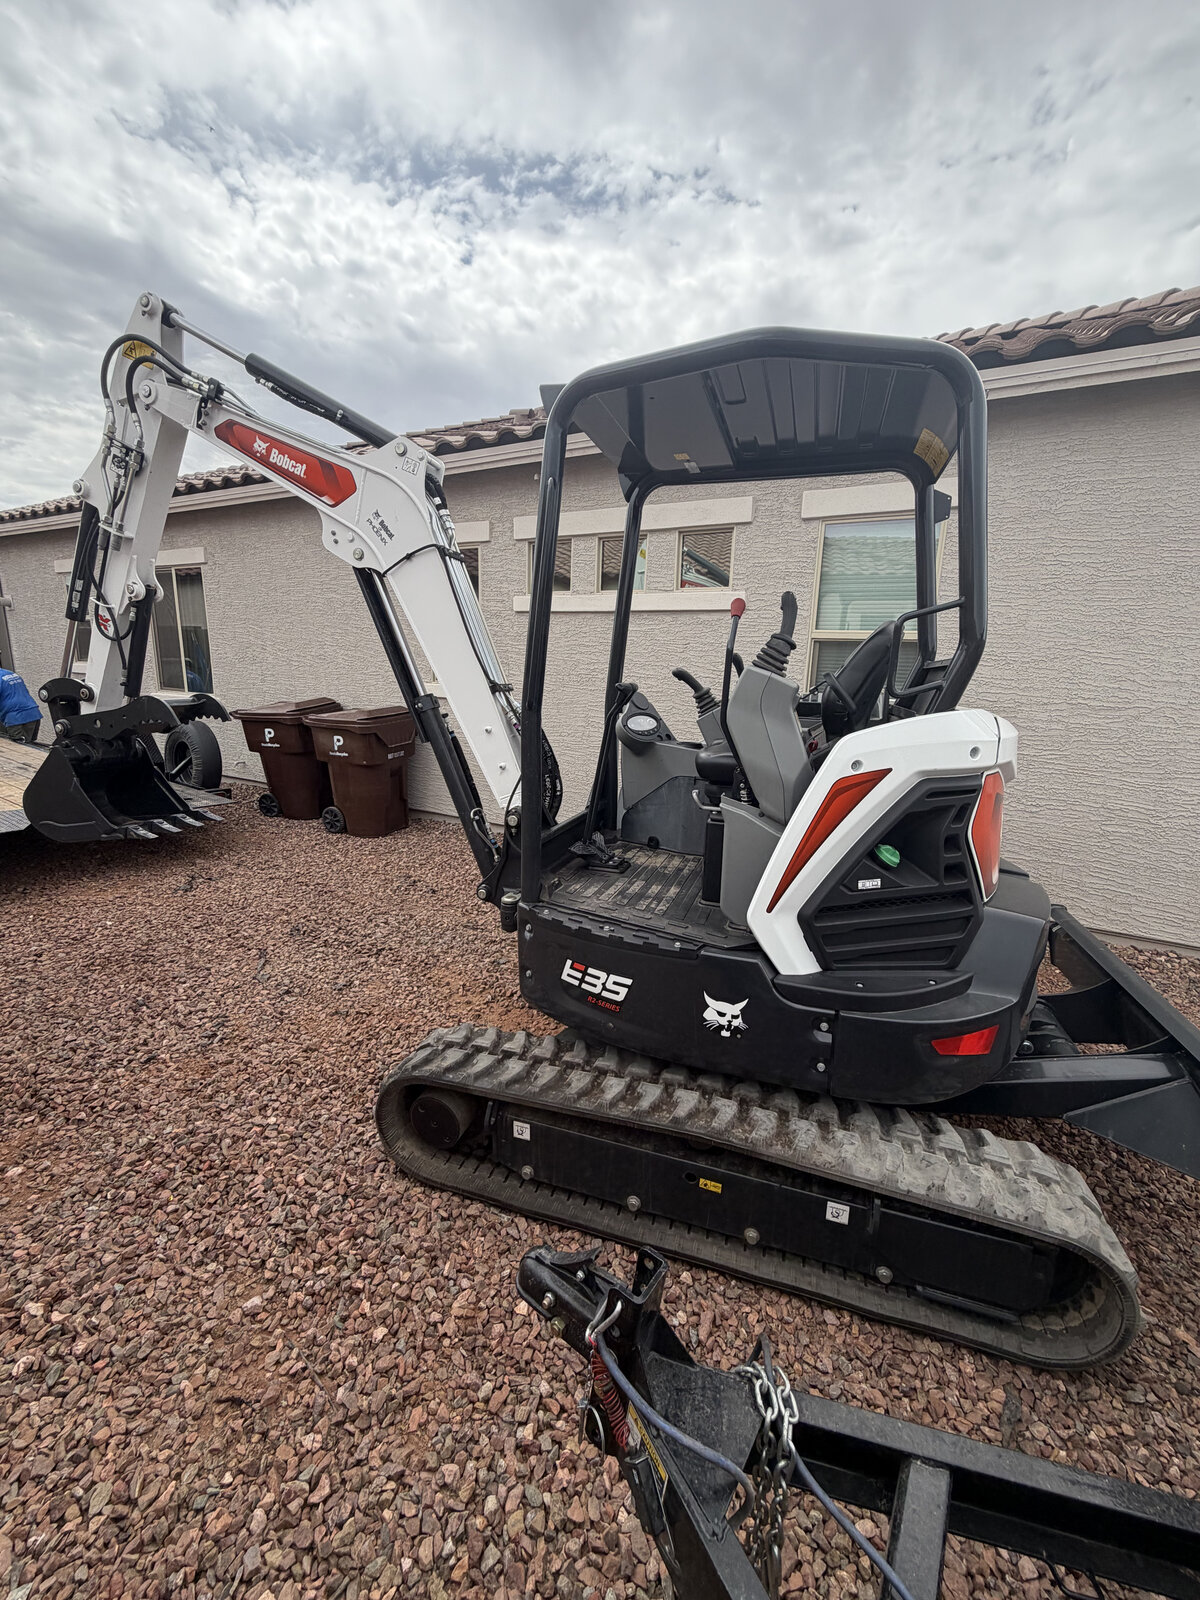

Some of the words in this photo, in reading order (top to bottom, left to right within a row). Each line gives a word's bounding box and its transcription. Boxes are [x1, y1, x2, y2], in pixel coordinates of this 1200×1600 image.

[269, 447, 307, 478] Bobcat
[379, 519, 395, 541] Bobcat
[264, 728, 275, 742] P
[333, 735, 344, 750] P
[560, 958, 633, 1002] E35
[587, 995, 620, 1012] R2-SERIES
